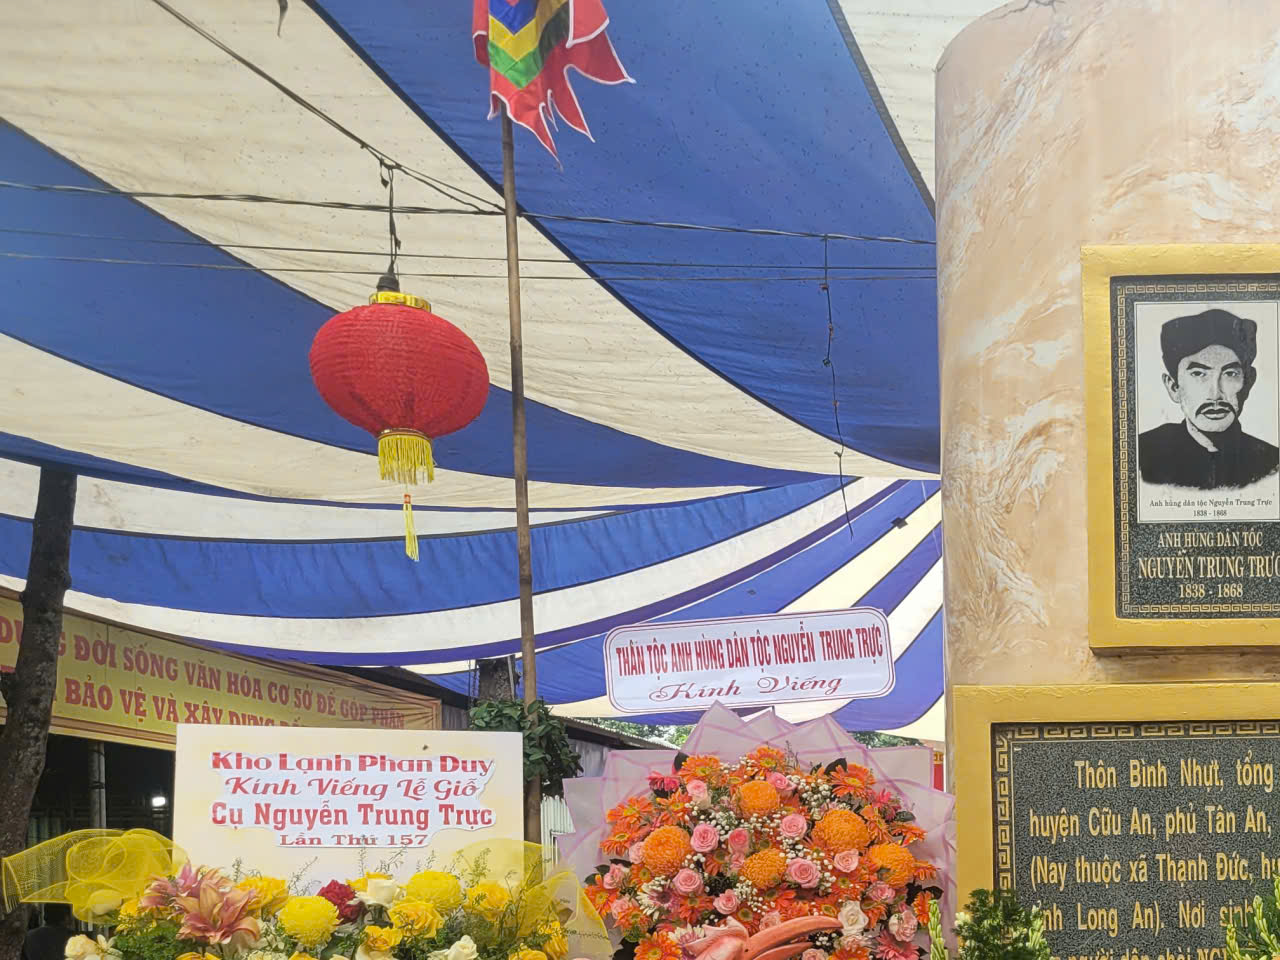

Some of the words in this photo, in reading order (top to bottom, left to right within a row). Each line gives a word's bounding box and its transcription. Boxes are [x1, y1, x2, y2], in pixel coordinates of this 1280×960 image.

[1158, 532, 1181, 548] ANH
[1184, 528, 1214, 548] HÙNG
[1217, 528, 1241, 547] DÂN
[1243, 528, 1263, 550] TỘC
[1138, 550, 1194, 579] NGUYỄN
[1198, 556, 1244, 578] TRUNG
[1179, 584, 1206, 598] 1838
[1217, 583, 1243, 597] 1868
[616, 640, 646, 677] THÂN
[647, 637, 668, 680] TỘC
[671, 642, 692, 673] ANH
[696, 634, 725, 671] HÙNG
[726, 631, 750, 668] DÂN
[750, 630, 771, 673] TỘC
[773, 621, 816, 664] NGUYỄN
[819, 628, 854, 661] TRUNG
[855, 623, 884, 664] TRỰC
[74, 633, 117, 668] ĐỜI
[123, 641, 178, 681] SỐNG
[184, 660, 221, 692] VĂN
[226, 671, 263, 701] HÓA
[267, 680, 290, 705] CƠ
[294, 683, 312, 710] SỞ
[317, 688, 336, 716] ĐỂ
[757, 675, 843, 695] Viếng
[65, 675, 113, 711] BẢO
[120, 687, 147, 722] VỆ
[152, 693, 179, 723] VÀ
[212, 752, 272, 771] Kho
[279, 754, 352, 774] Lạnh
[358, 755, 433, 772] Phan
[440, 755, 493, 777] Duy
[1074, 760, 1117, 789] Thôn
[1129, 757, 1168, 787] Bình
[1180, 758, 1224, 792] Nhựt,
[1236, 750, 1274, 793] tổng
[225, 777, 301, 795] Kính
[308, 777, 388, 801] Viếng
[396, 778, 427, 800] Lễ
[433, 778, 479, 800] Giỗ
[212, 802, 243, 830] Cụ
[254, 800, 348, 831] Nguyễn
[358, 804, 429, 831] Trung
[439, 804, 493, 830] Trực
[1029, 806, 1079, 845] huyện
[1129, 808, 1157, 840] An,
[1165, 802, 1196, 840] phủ
[1205, 805, 1236, 834] Tân
[1245, 805, 1271, 838] An,
[280, 832, 321, 846] Lần
[331, 833, 377, 846] Thứ
[388, 834, 428, 846] 157
[1030, 855, 1065, 891] (Nay
[1075, 854, 1121, 888] thuộc
[1128, 855, 1148, 882] xã
[1155, 853, 1208, 887] Thạnh
[1216, 851, 1253, 884] Đức,
[1077, 902, 1118, 937] Long
[1132, 901, 1165, 936] An).
[1178, 900, 1205, 929] Nơi
